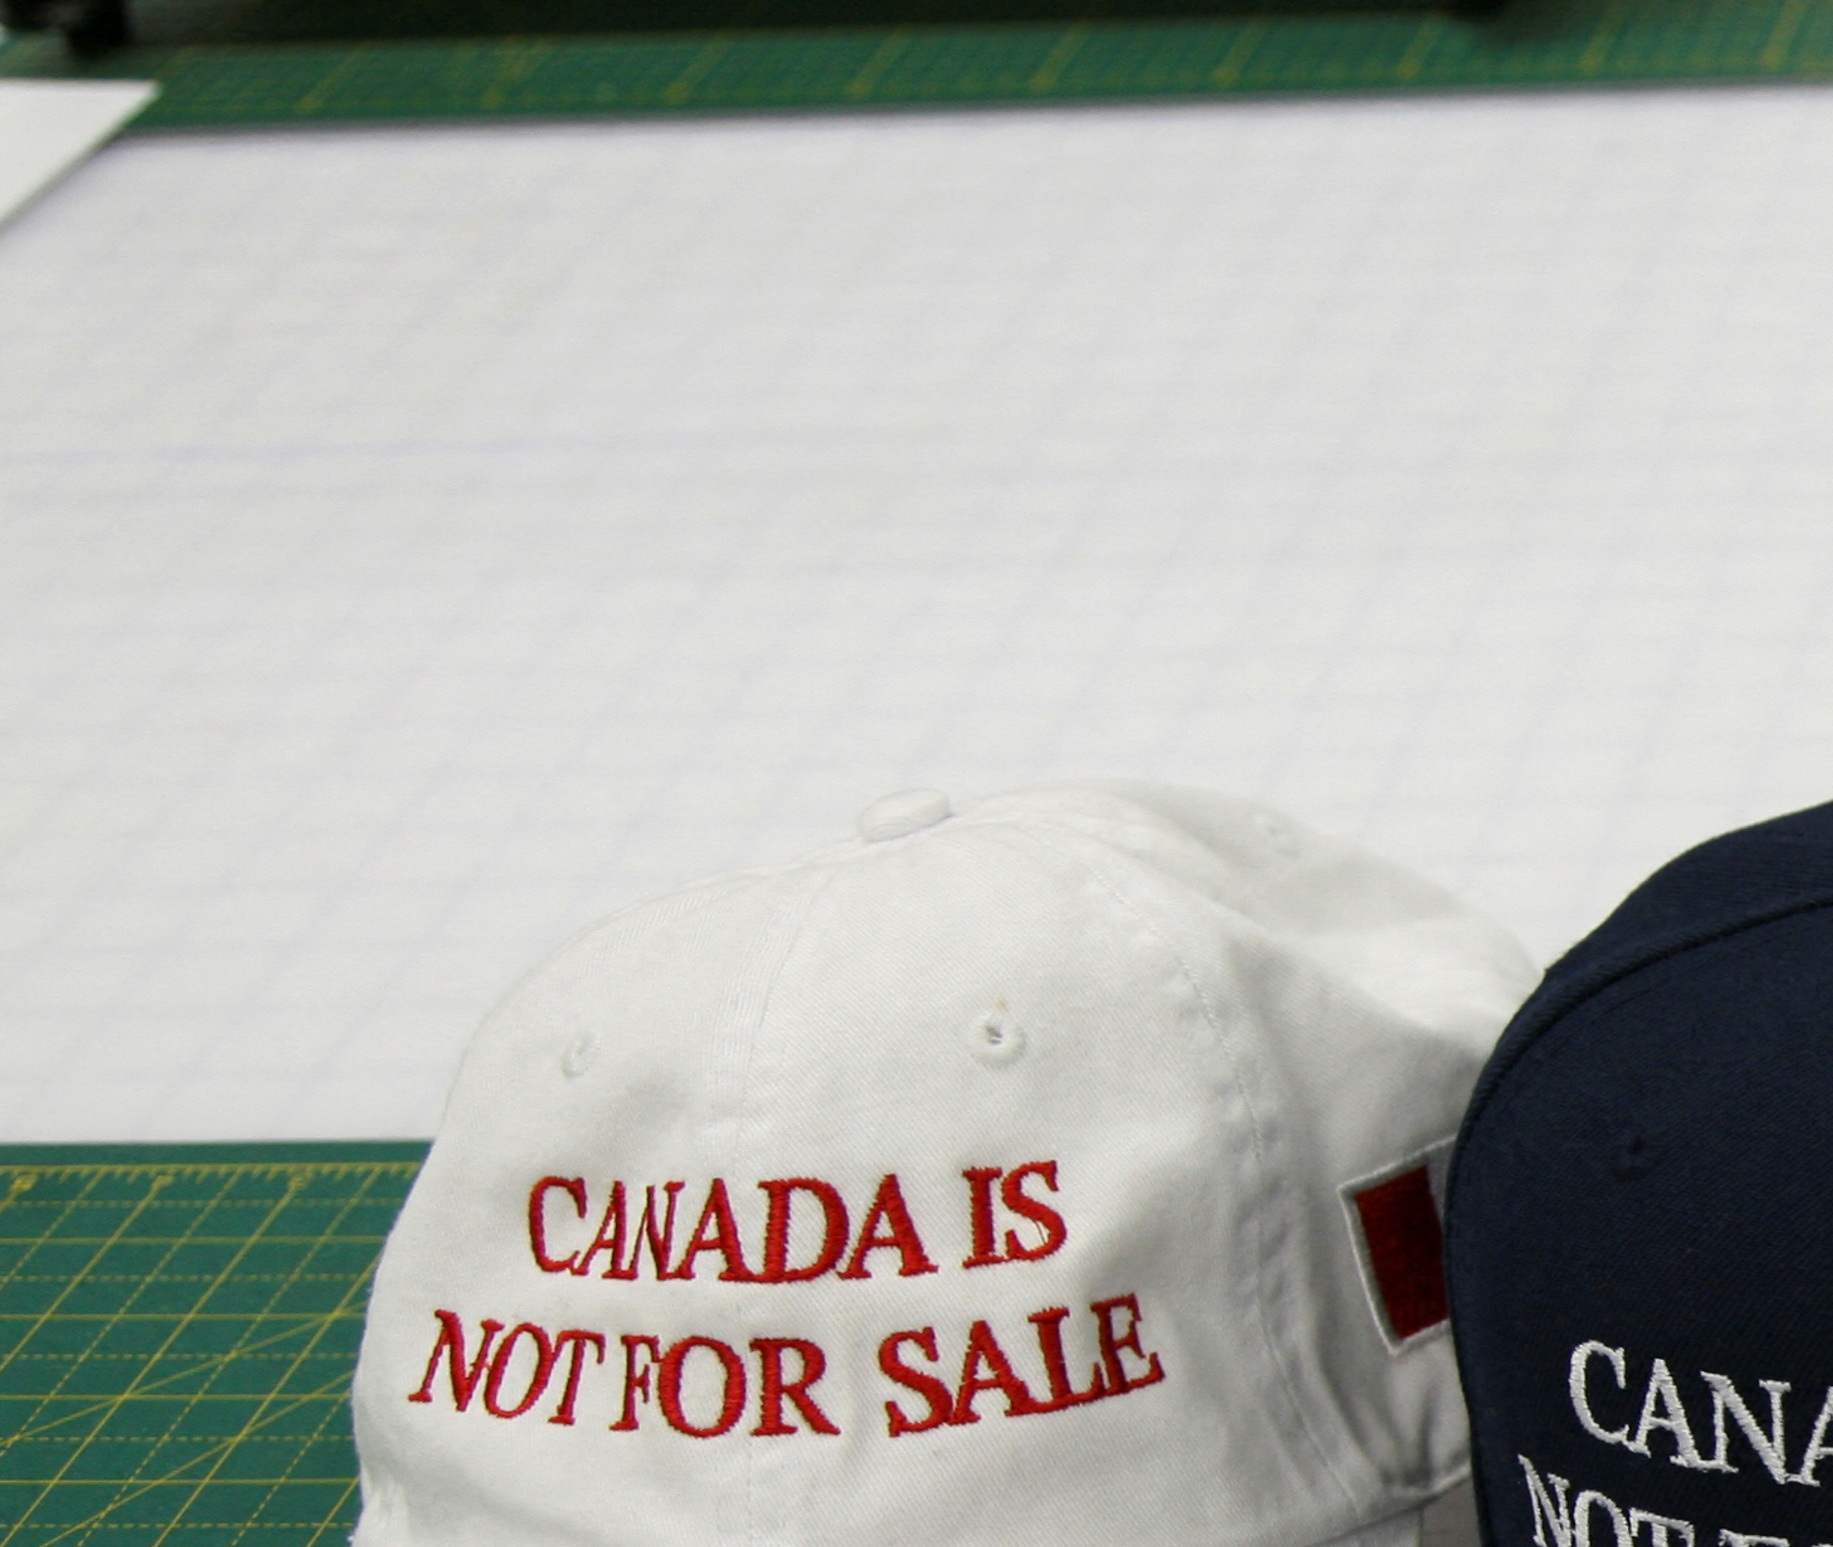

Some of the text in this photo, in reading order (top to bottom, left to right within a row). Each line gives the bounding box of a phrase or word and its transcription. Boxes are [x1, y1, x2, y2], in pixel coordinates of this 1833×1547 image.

[528, 1161, 1068, 1283] CANADA IS
[409, 1293, 1166, 1438] NOT FOR SALE
